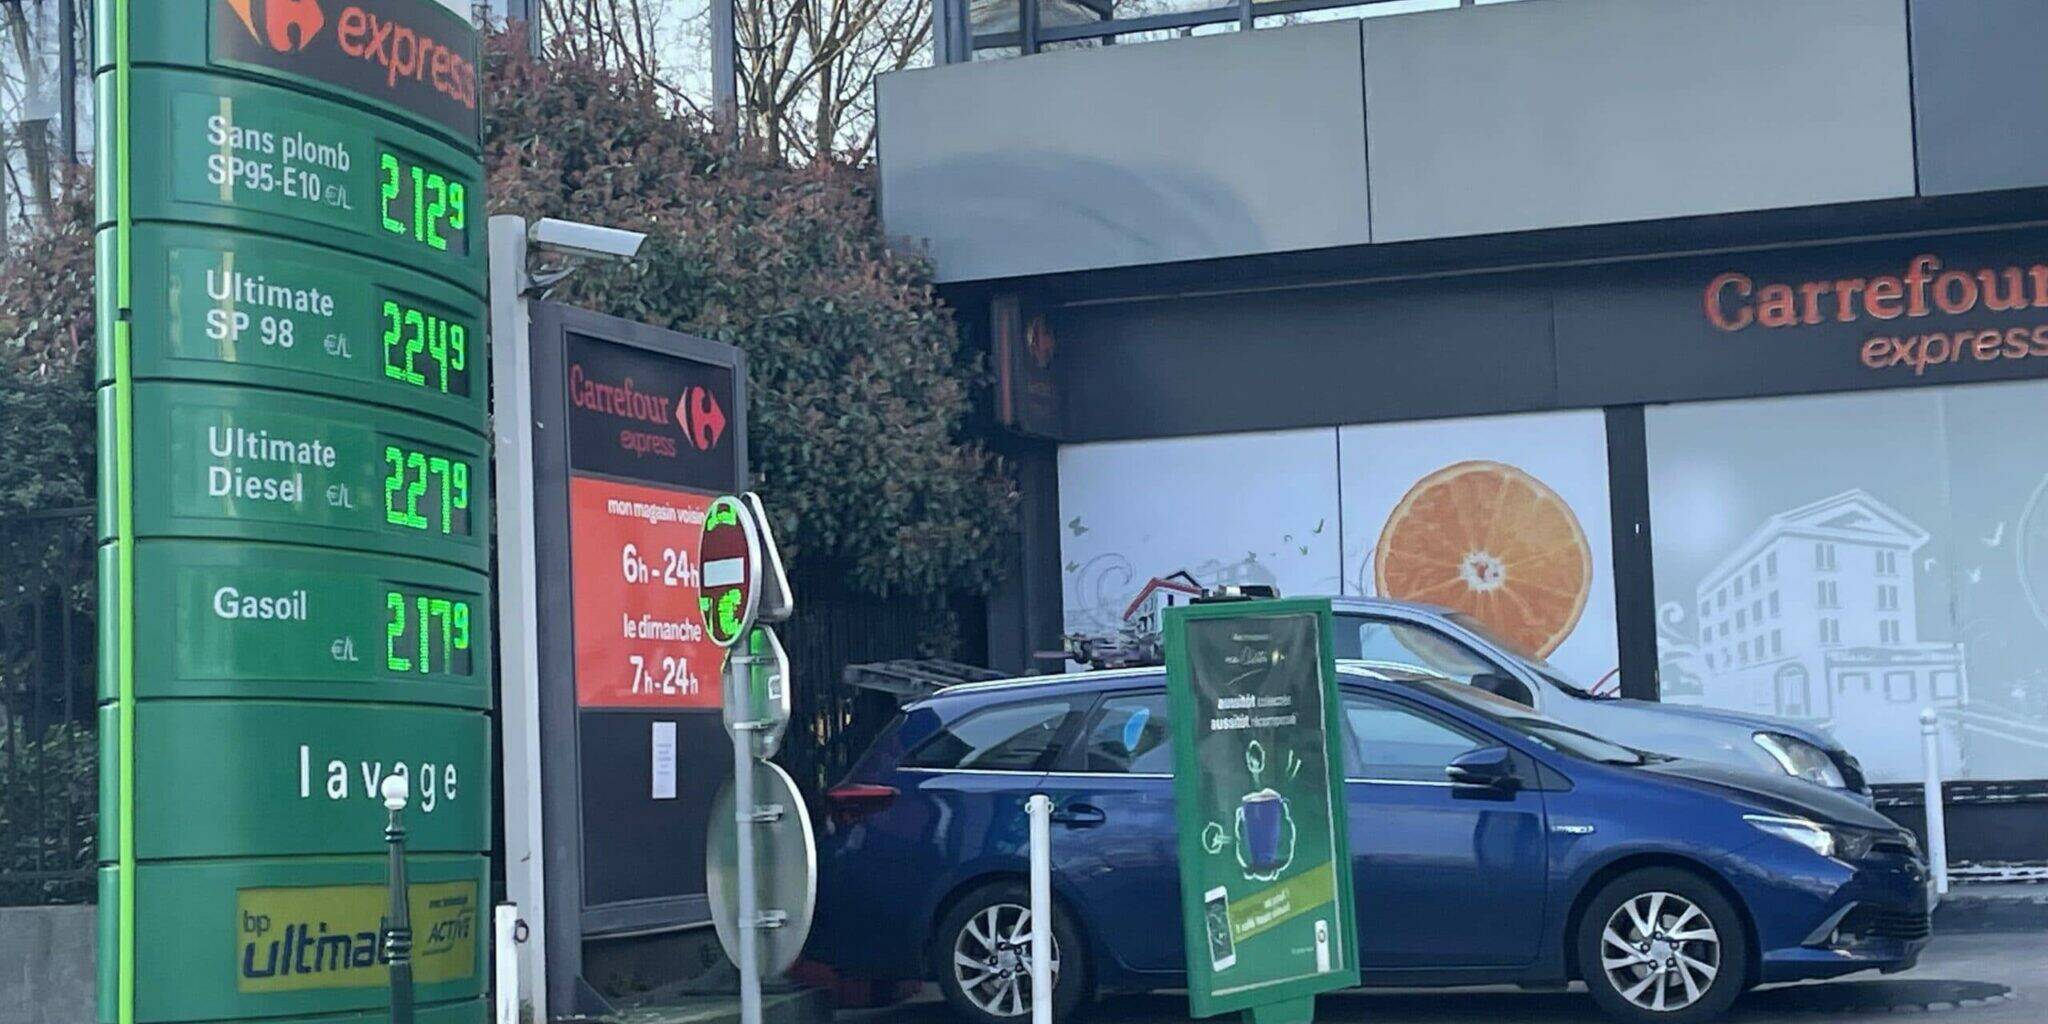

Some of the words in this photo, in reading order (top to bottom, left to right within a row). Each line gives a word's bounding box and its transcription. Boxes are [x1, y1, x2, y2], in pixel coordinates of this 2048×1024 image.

[338, 6, 476, 109] express
[207, 115, 275, 154] Sans
[282, 131, 350, 172] plomb
[208, 154, 321, 202] SP95-E10
[206, 270, 334, 317] Ultimate
[1703, 254, 2048, 332] Carrefour
[206, 309, 250, 341] SP
[260, 316, 294, 348] 98
[1860, 325, 2048, 376] express
[570, 364, 669, 425] Carrefour
[208, 426, 336, 468] Ultimate
[619, 429, 676, 457] express
[208, 466, 303, 503] Diesel
[607, 499, 633, 517] mon
[633, 501, 677, 525] magasin
[213, 586, 308, 620] Gasoil
[623, 612, 638, 639] le
[639, 614, 702, 642] dimanche
[300, 744, 457, 812] lavage
[243, 910, 271, 937] bp
